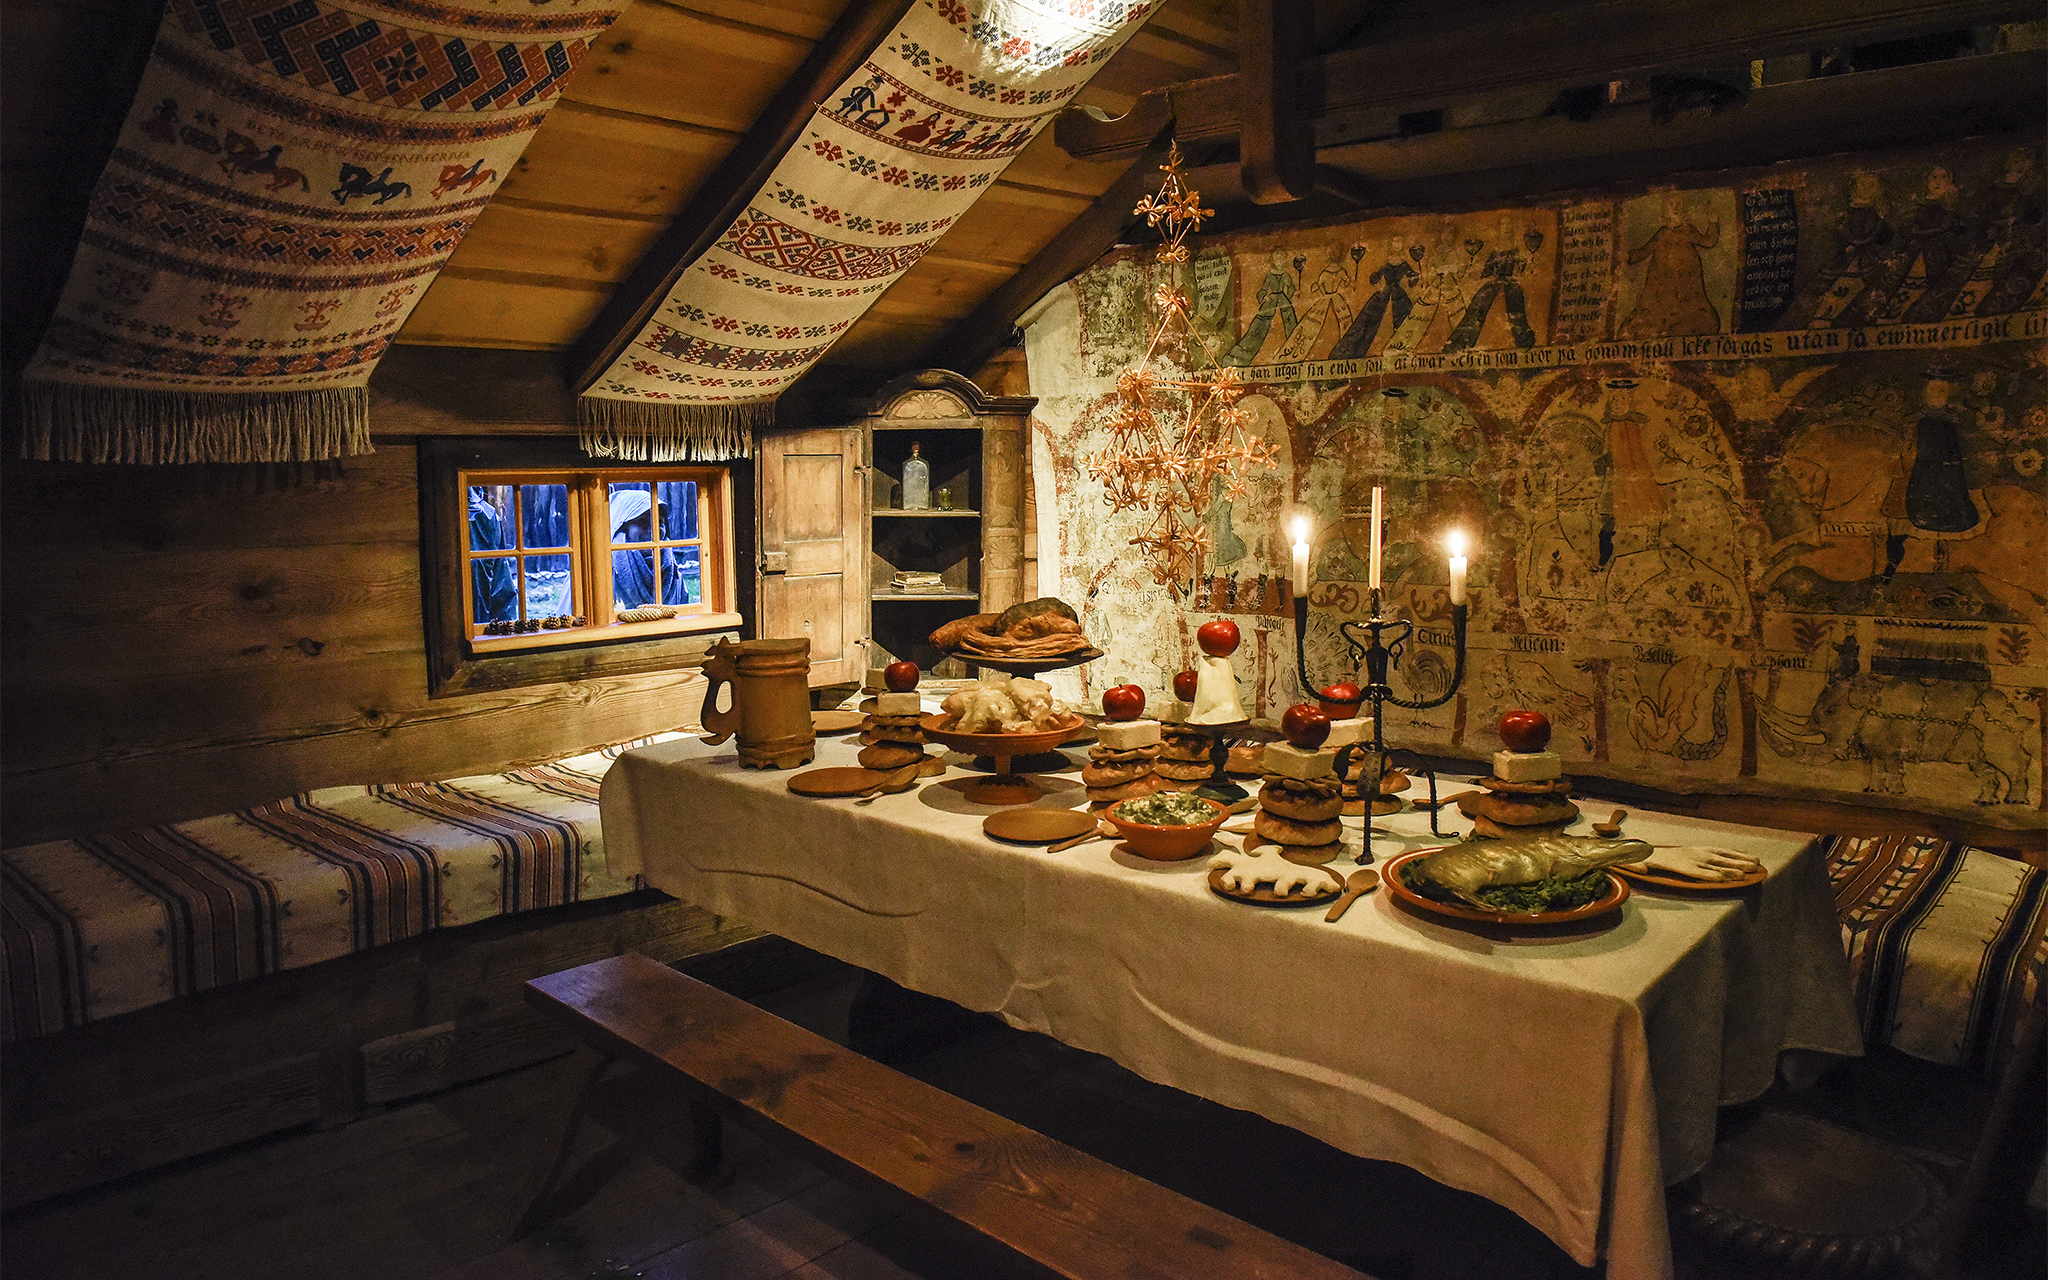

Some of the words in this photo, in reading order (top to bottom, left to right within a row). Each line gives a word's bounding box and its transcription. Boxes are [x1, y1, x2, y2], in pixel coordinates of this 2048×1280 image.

[1329, 359, 1358, 376] enda
[1682, 337, 1711, 357] icke
[1786, 330, 1839, 351] utan
